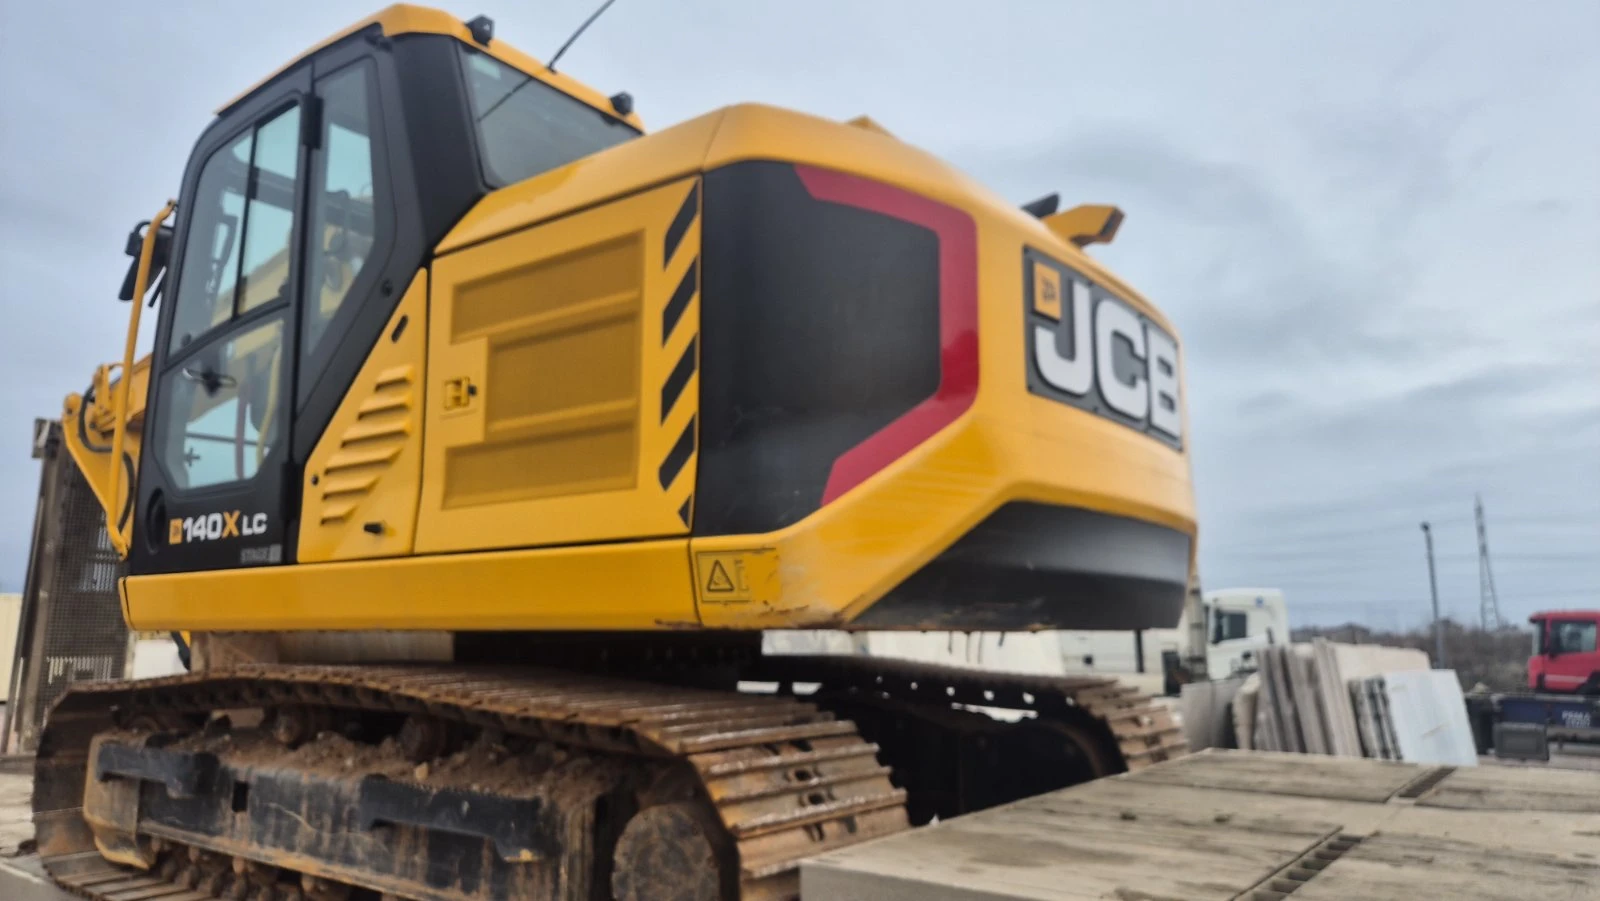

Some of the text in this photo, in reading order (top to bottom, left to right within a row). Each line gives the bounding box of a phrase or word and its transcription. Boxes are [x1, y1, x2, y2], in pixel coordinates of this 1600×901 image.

[1034, 280, 1182, 441] JCB
[183, 510, 268, 543] 140X LC
